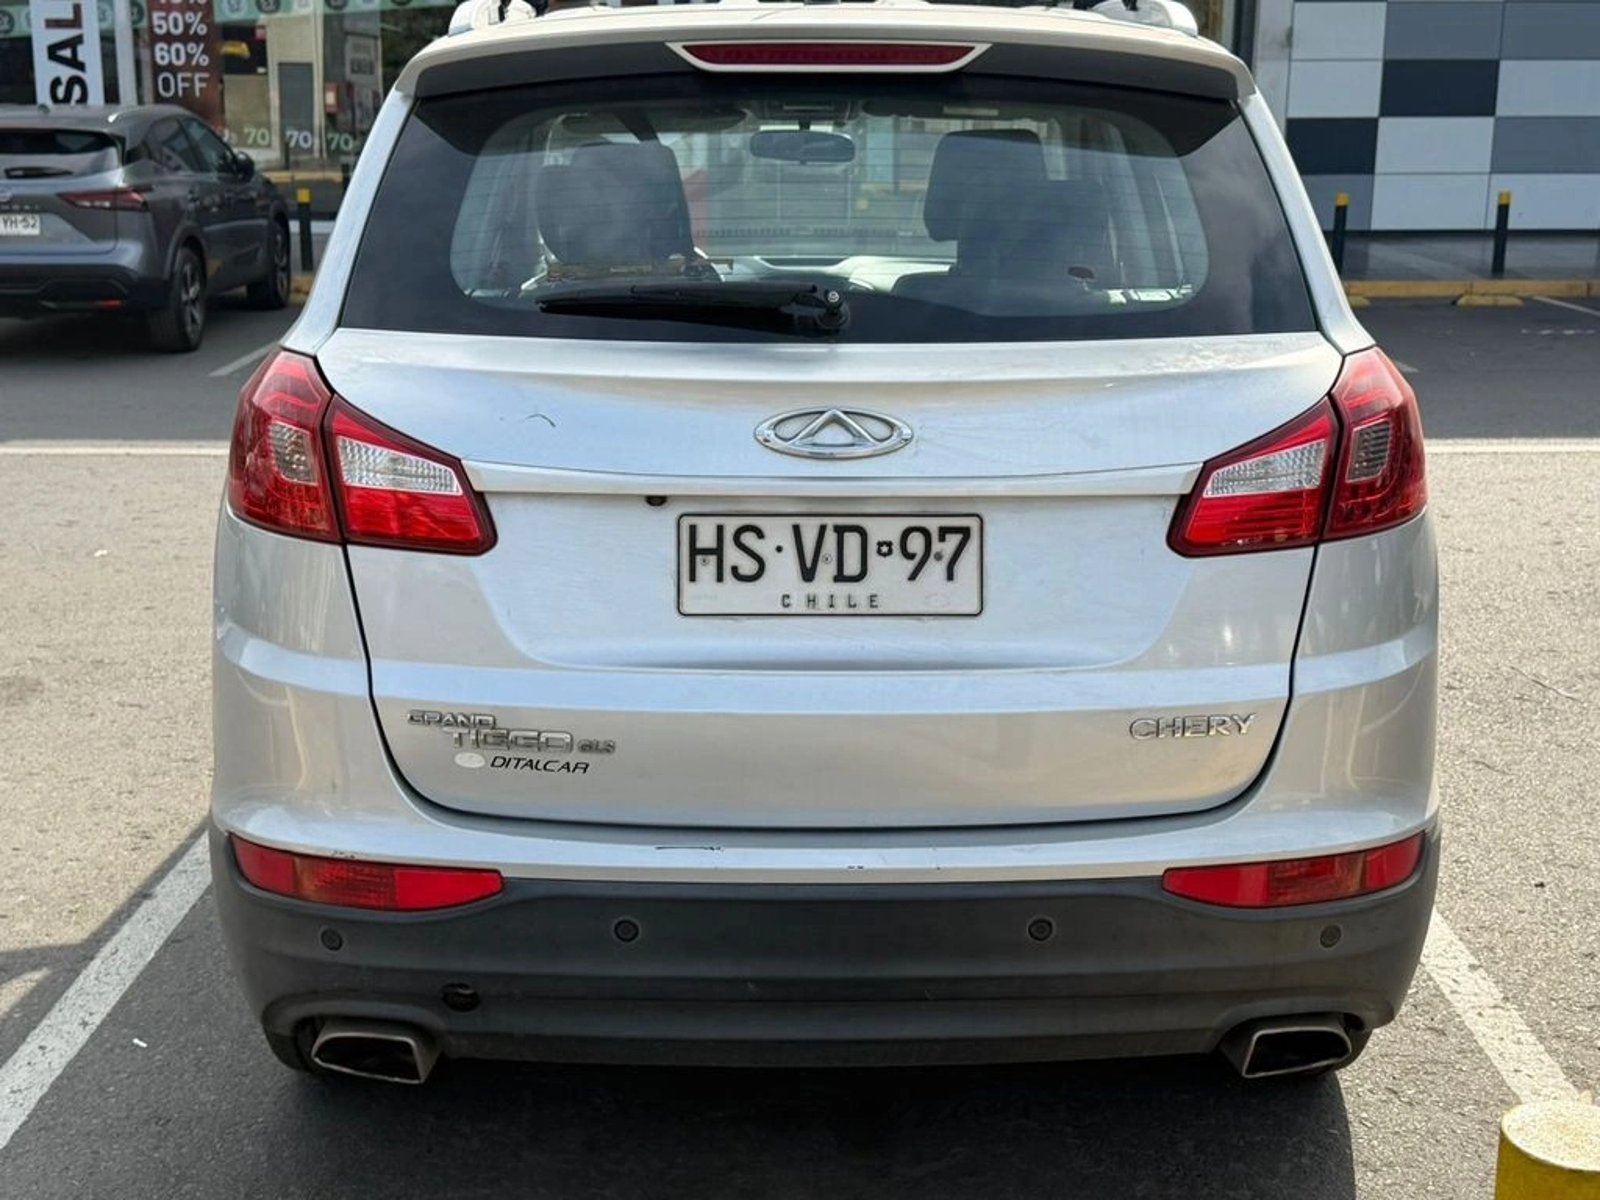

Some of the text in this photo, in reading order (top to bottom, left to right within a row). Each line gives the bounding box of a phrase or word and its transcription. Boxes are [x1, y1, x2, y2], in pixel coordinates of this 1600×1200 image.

[152, 11, 207, 36] 50%
[154, 42, 209, 67] 60%
[157, 72, 210, 98] OFF
[286, 129, 313, 149] 70
[782, 593, 879, 609] CHILE
[1129, 711, 1257, 741] CHERY
[490, 755, 590, 774] DITALCAR
